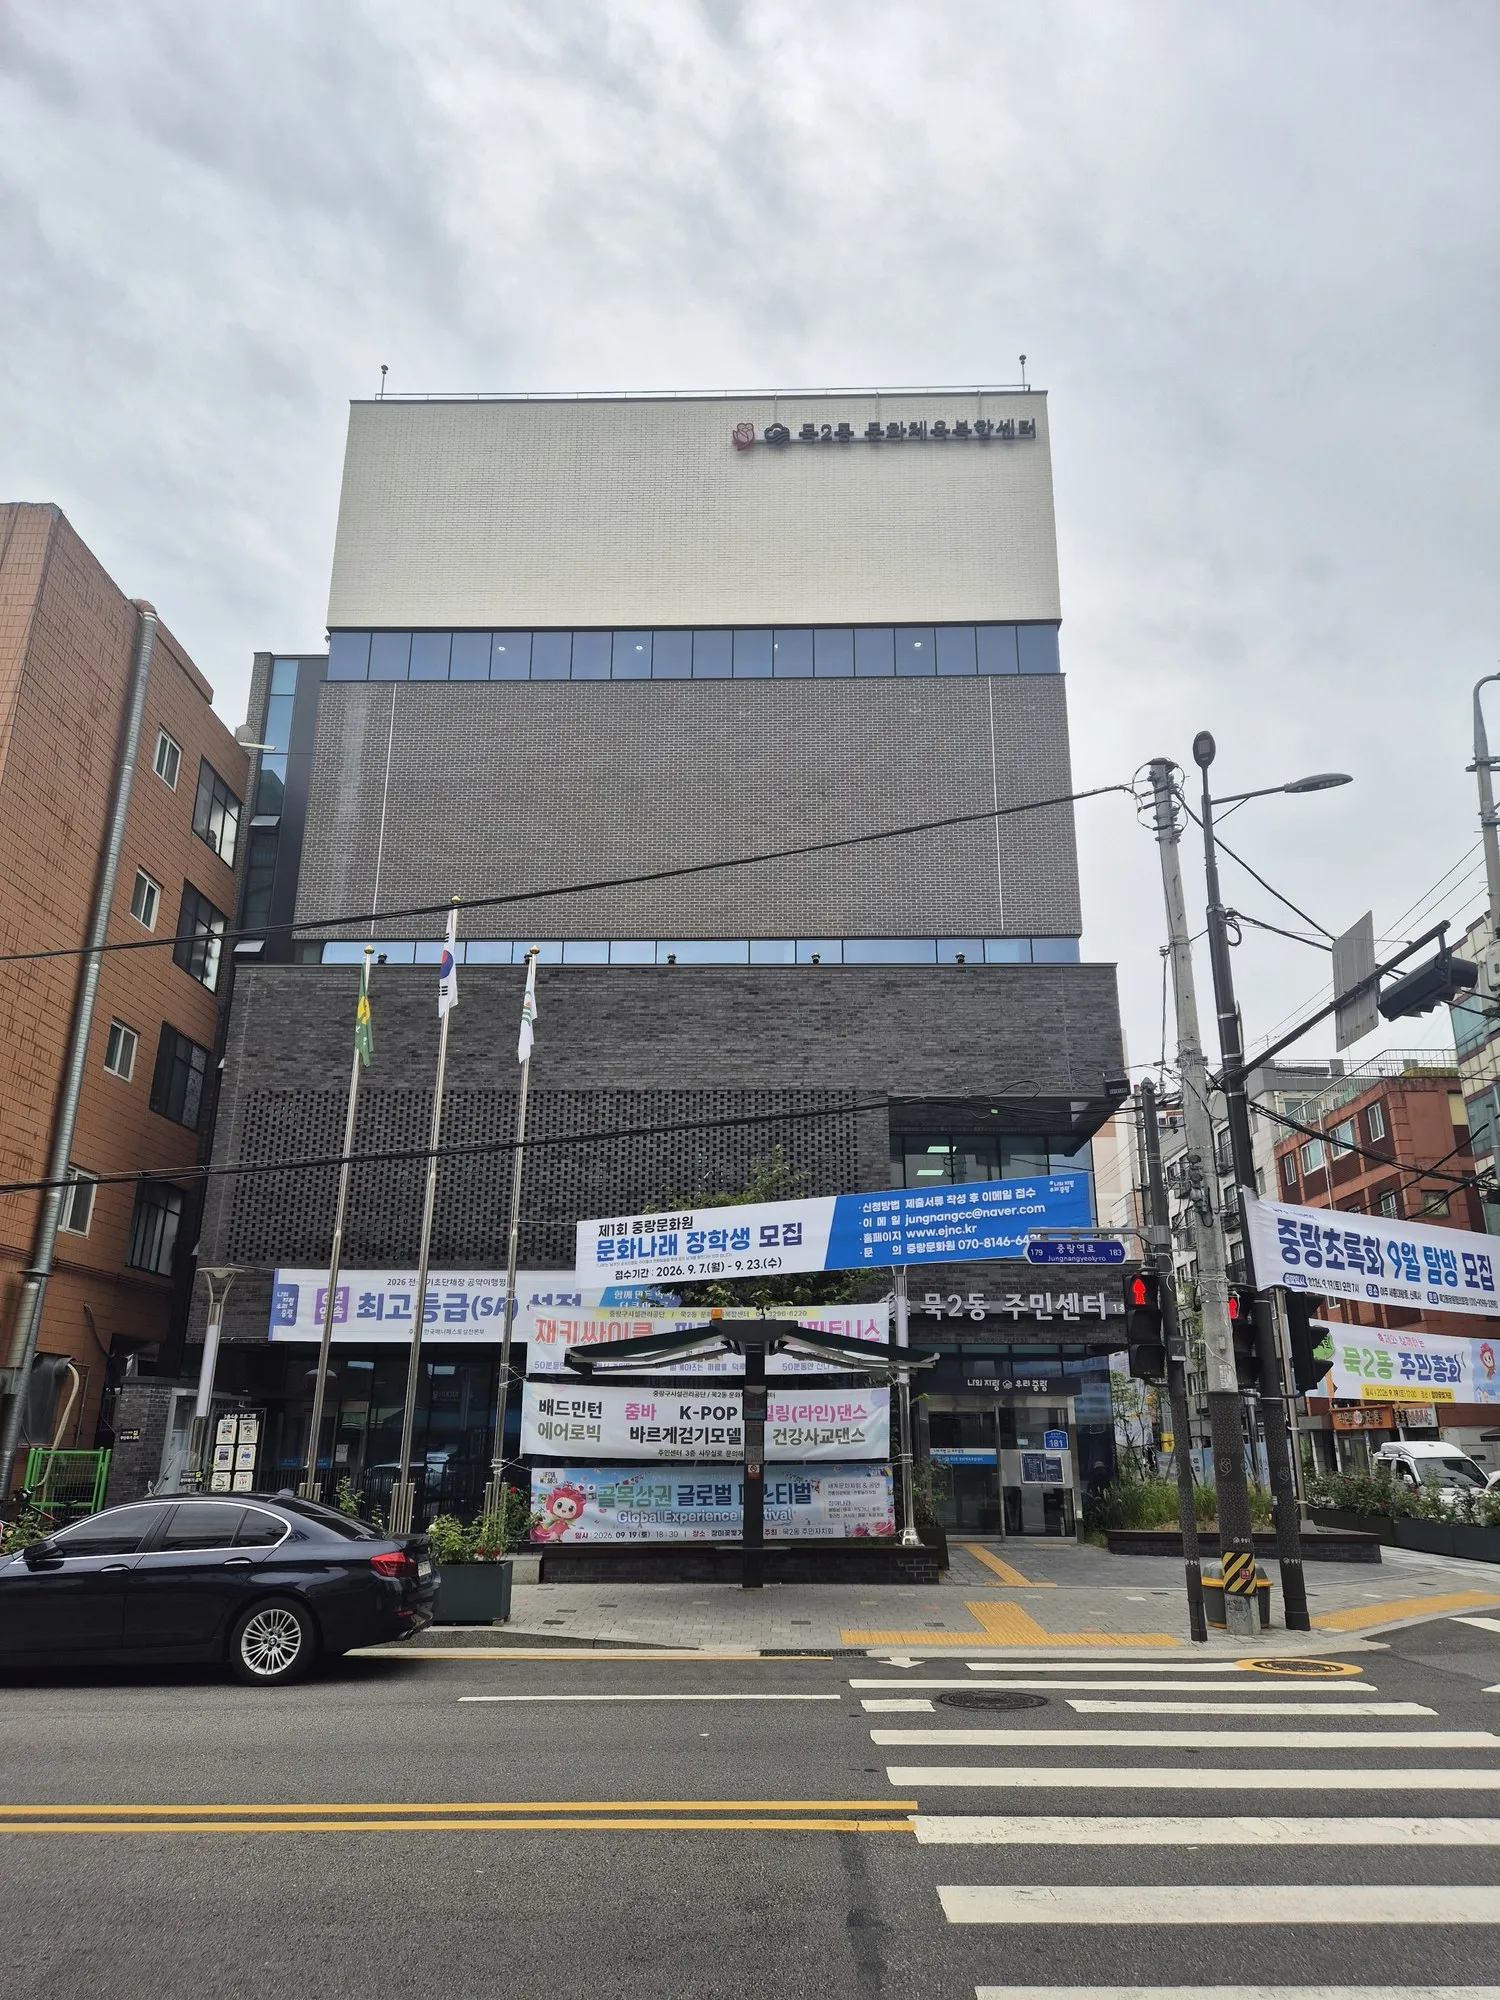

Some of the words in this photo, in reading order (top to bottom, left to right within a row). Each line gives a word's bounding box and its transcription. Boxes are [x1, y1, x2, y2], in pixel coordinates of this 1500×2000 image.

[799, 423, 854, 443] 묵2동
[863, 1200, 900, 1213] 신청방법
[905, 1196, 944, 1209] 제출서류
[947, 1194, 966, 1205] 작성
[969, 1193, 979, 1203] 후
[982, 1189, 1013, 1202] 이메일
[1016, 1187, 1036, 1199] 접수
[905, 1203, 1046, 1227] jungnangcc@naver.com
[598, 1222, 628, 1237] 제1회
[632, 1216, 693, 1235] 중랑문화원
[863, 1230, 901, 1244] 홈페이지
[906, 1223, 977, 1238] www.ejnc.kr
[597, 1233, 678, 1262] 문화나래
[686, 1227, 750, 1255] 장학생
[759, 1222, 802, 1248] 모집
[906, 1240, 956, 1254] 중랑문화원
[1057, 1243, 1096, 1254] 중랑역로
[1277, 1217, 1385, 1278] 중랑초록회
[1387, 1239, 1422, 1283] 9월
[1422, 1245, 1459, 1288] 탐방
[1461, 1251, 1495, 1292] 모집
[615, 1268, 649, 1281] 접수기간
[656, 1266, 685, 1277] 2026.
[699, 1262, 725, 1273] 7.(월)
[747, 1257, 782, 1270] 23.(수)
[387, 1278, 406, 1286] 2026
[426, 1278, 465, 1287] 기초단체장
[1367, 1284, 1379, 1297] 장소
[614, 1290, 633, 1300] 함께
[700, 1310, 750, 1318] 문화복합센터
[920, 1292, 991, 1321] 묵2동
[1002, 1292, 1107, 1321] 주민센터
[1342, 1346, 1394, 1380] 묵2동
[1398, 1351, 1462, 1383] 주민총회
[711, 1391, 728, 1399] 묵2동
[967, 1379, 983, 1387] 나의
[984, 1379, 1000, 1392] 자랑
[1015, 1379, 1031, 1388] 우리
[1032, 1379, 1048, 1392] 중랑
[538, 1399, 603, 1420] 배드민턴
[624, 1402, 657, 1421] 줌바
[679, 1406, 738, 1421] K-POP
[538, 1422, 601, 1443] 에어로빅
[629, 1425, 742, 1446] 바르게걷기모델
[772, 1427, 866, 1446] 건강사교댄스
[1049, 1439, 1063, 1448] 181
[658, 1449, 682, 1457] 주민센터
[597, 1484, 672, 1508] 골목상권
[677, 1483, 732, 1507] 글로벌
[617, 1510, 662, 1523] Global
[663, 1508, 738, 1524] Experience
[782, 1528, 800, 1536] 묵2동
[801, 1527, 834, 1535] 주민자치회
